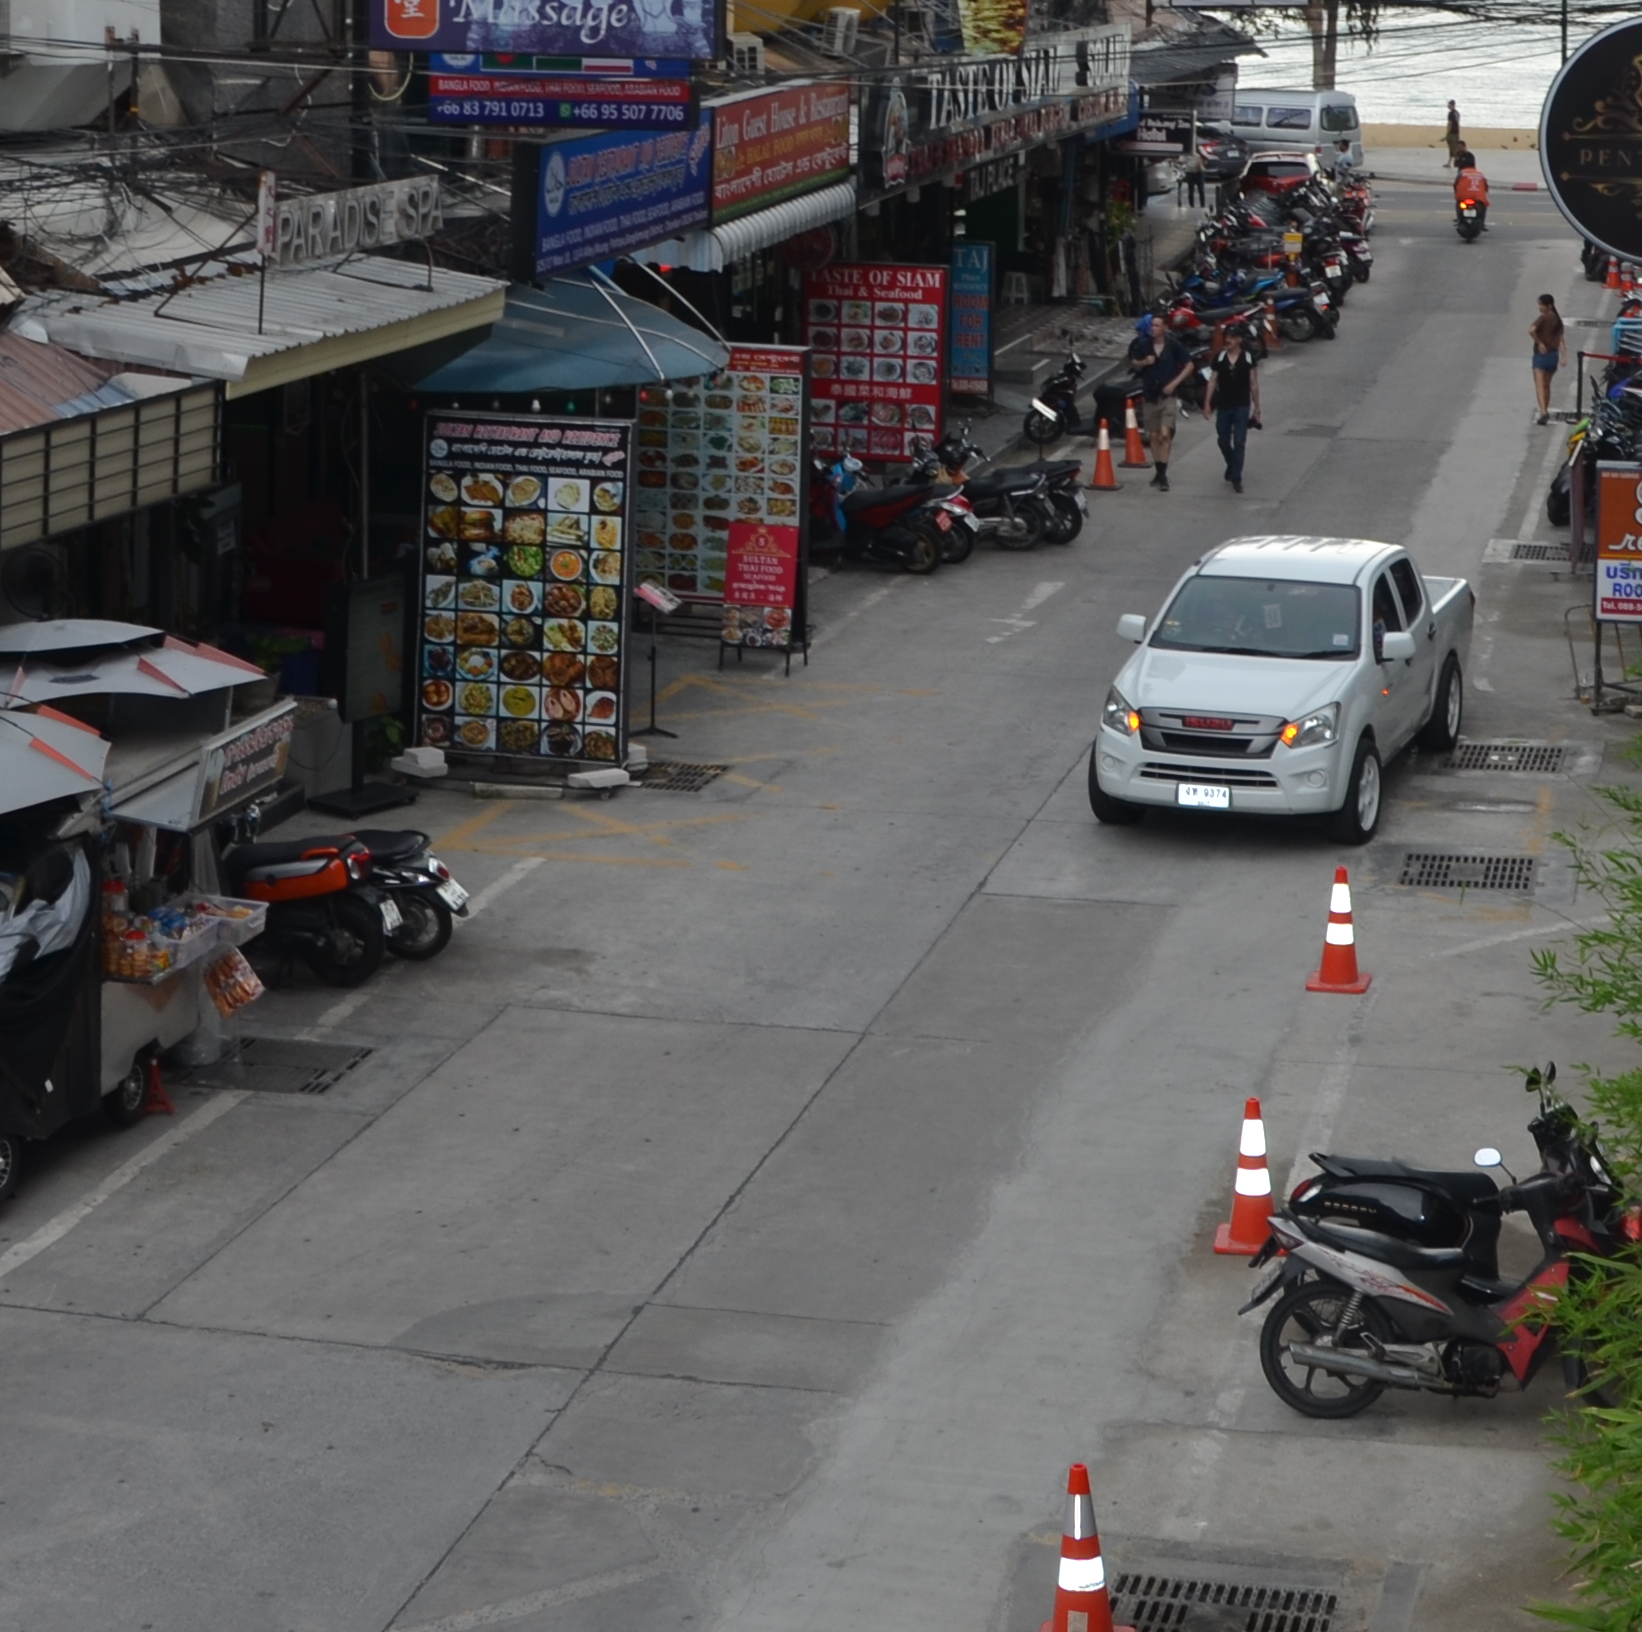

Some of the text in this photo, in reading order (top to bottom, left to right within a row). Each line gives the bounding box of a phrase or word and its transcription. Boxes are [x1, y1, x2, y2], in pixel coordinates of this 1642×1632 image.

[927, 63, 990, 130] TASTE
[462, 101, 480, 116] 83
[483, 101, 507, 116] 791
[511, 102, 544, 117] 0713
[573, 103, 598, 118] +66
[601, 104, 618, 119] 95
[622, 104, 646, 119] 507
[650, 105, 684, 120] 7706
[743, 110, 767, 141] Guest
[771, 102, 796, 133] House
[278, 189, 395, 266] PARADISE
[397, 182, 445, 240] SPA
[954, 249, 989, 273] TAJ
[811, 270, 941, 288] TASTE OF SIAM
[827, 285, 923, 300] Thai & Seafood
[953, 294, 989, 310] ROOM
[960, 314, 983, 329] FOR
[955, 333, 986, 348] RENT
[743, 555, 778, 565] SULTAN
[1185, 716, 1234, 730] ISUZU
